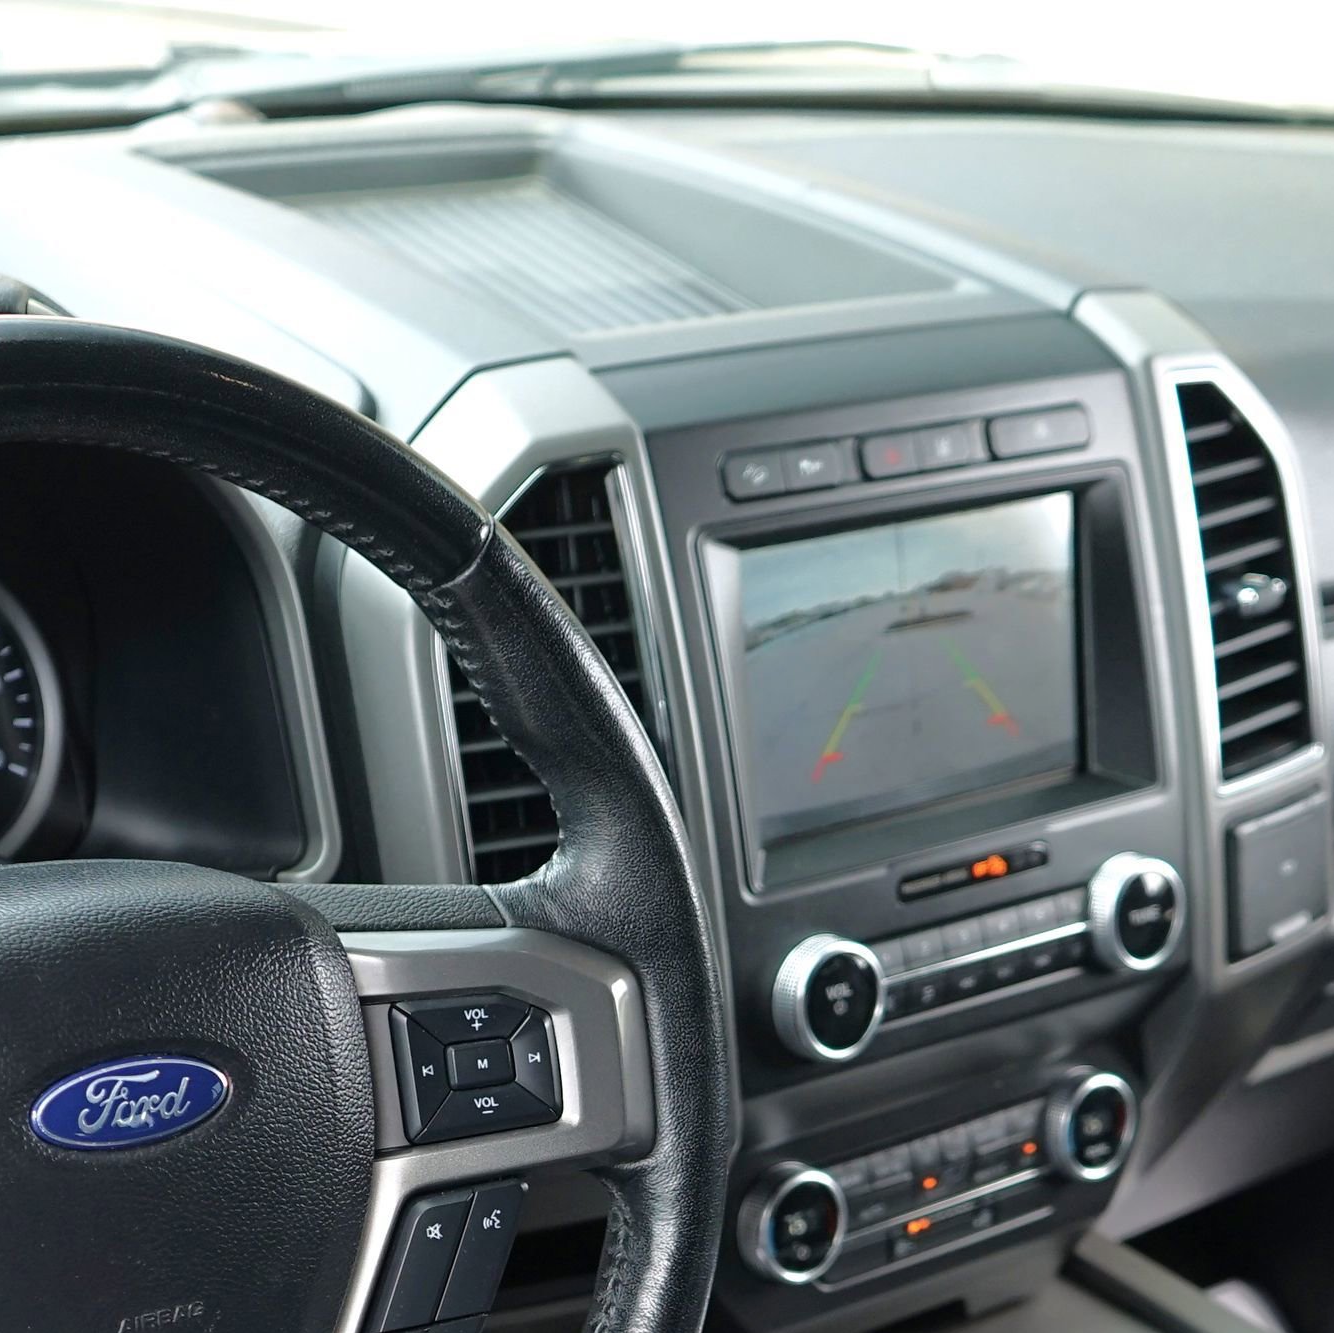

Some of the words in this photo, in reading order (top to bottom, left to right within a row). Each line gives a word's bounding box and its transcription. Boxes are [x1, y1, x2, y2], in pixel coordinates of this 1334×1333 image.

[464, 1008, 489, 1020] VOL
[477, 1059, 488, 1069] M
[78, 1068, 192, 1134] Ford
[473, 1096, 499, 1109] VOL
